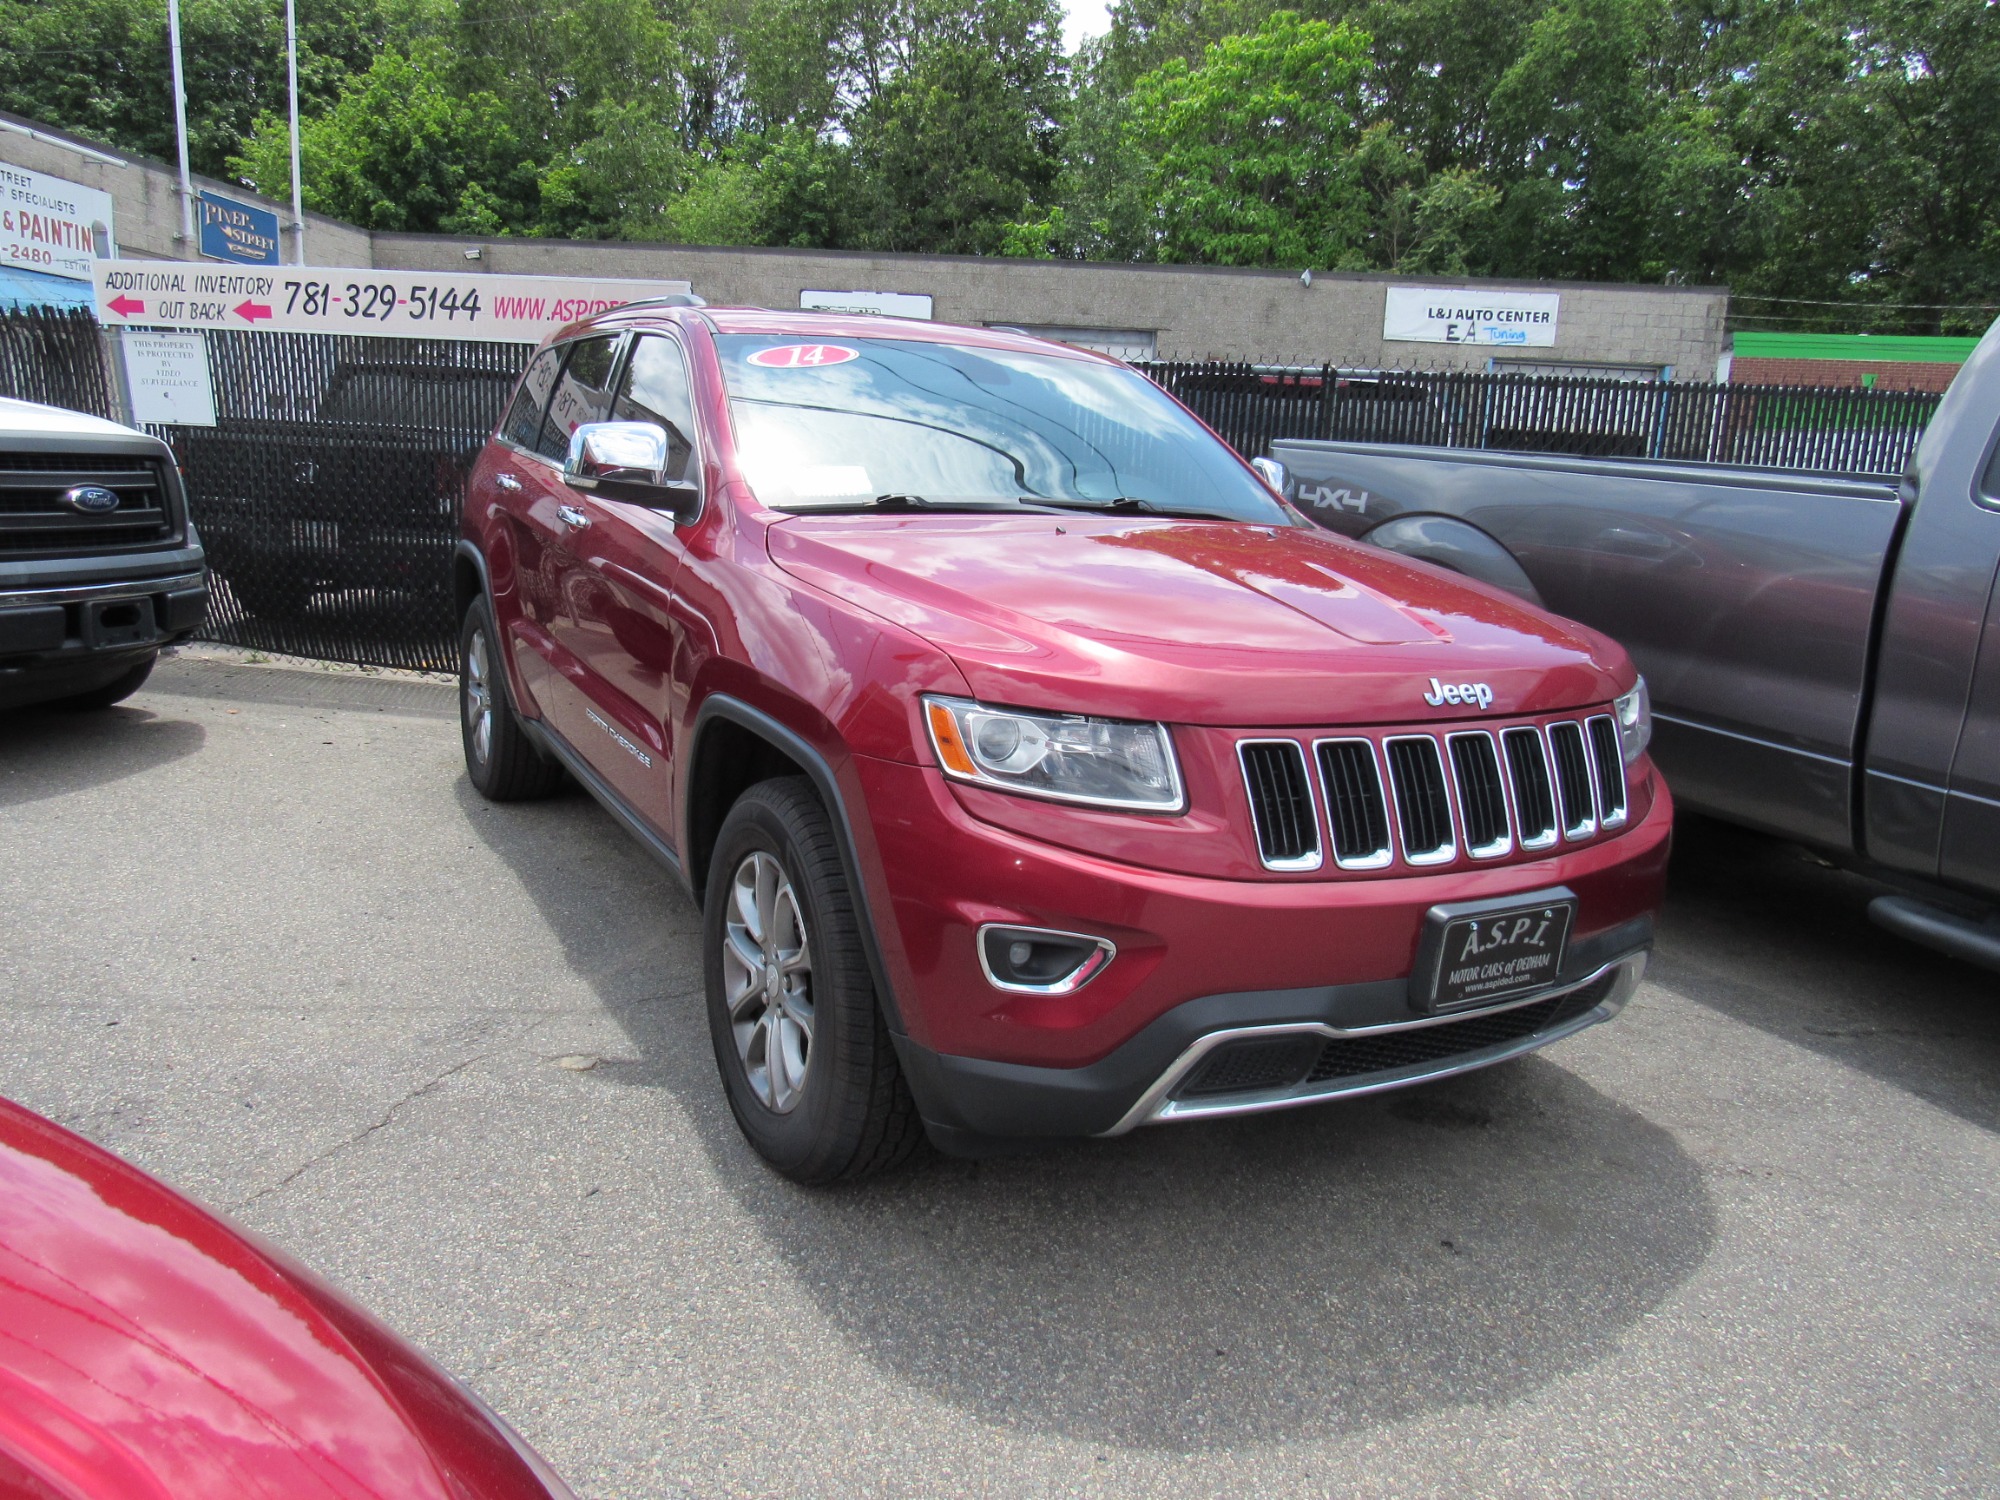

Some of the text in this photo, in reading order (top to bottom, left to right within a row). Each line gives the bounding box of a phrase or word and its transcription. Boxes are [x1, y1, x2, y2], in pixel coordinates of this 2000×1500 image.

[0, 170, 32, 188] TREET
[11, 189, 76, 215] SPECIALISTS
[3, 210, 92, 253] & PAINTIN
[232, 229, 275, 251] STREET
[1, 243, 52, 266] -2480
[64, 261, 91, 272] ESTIMA
[105, 271, 275, 297] ADDITIONAL INVENTORY
[159, 301, 227, 321] OUT BACK
[284, 281, 628, 323] 781-329-5144 WWW.ASPID
[1428, 308, 1550, 324] L&J AUTO CENTER
[1446, 324, 1461, 342] E
[1483, 327, 1526, 344] Tuning
[146, 351, 194, 359] PROTECTED
[153, 341, 194, 350] PROPERTY
[784, 345, 825, 367] 14
[140, 378, 199, 387] SURVEILLANCE
[156, 369, 181, 377] VIDEO
[1298, 484, 1369, 514] 4X4
[1423, 677, 1493, 710] Jeep
[1448, 953, 1551, 985] MOTOR CARS of DEDHAM
[1464, 973, 1530, 993] www.aspided.com
